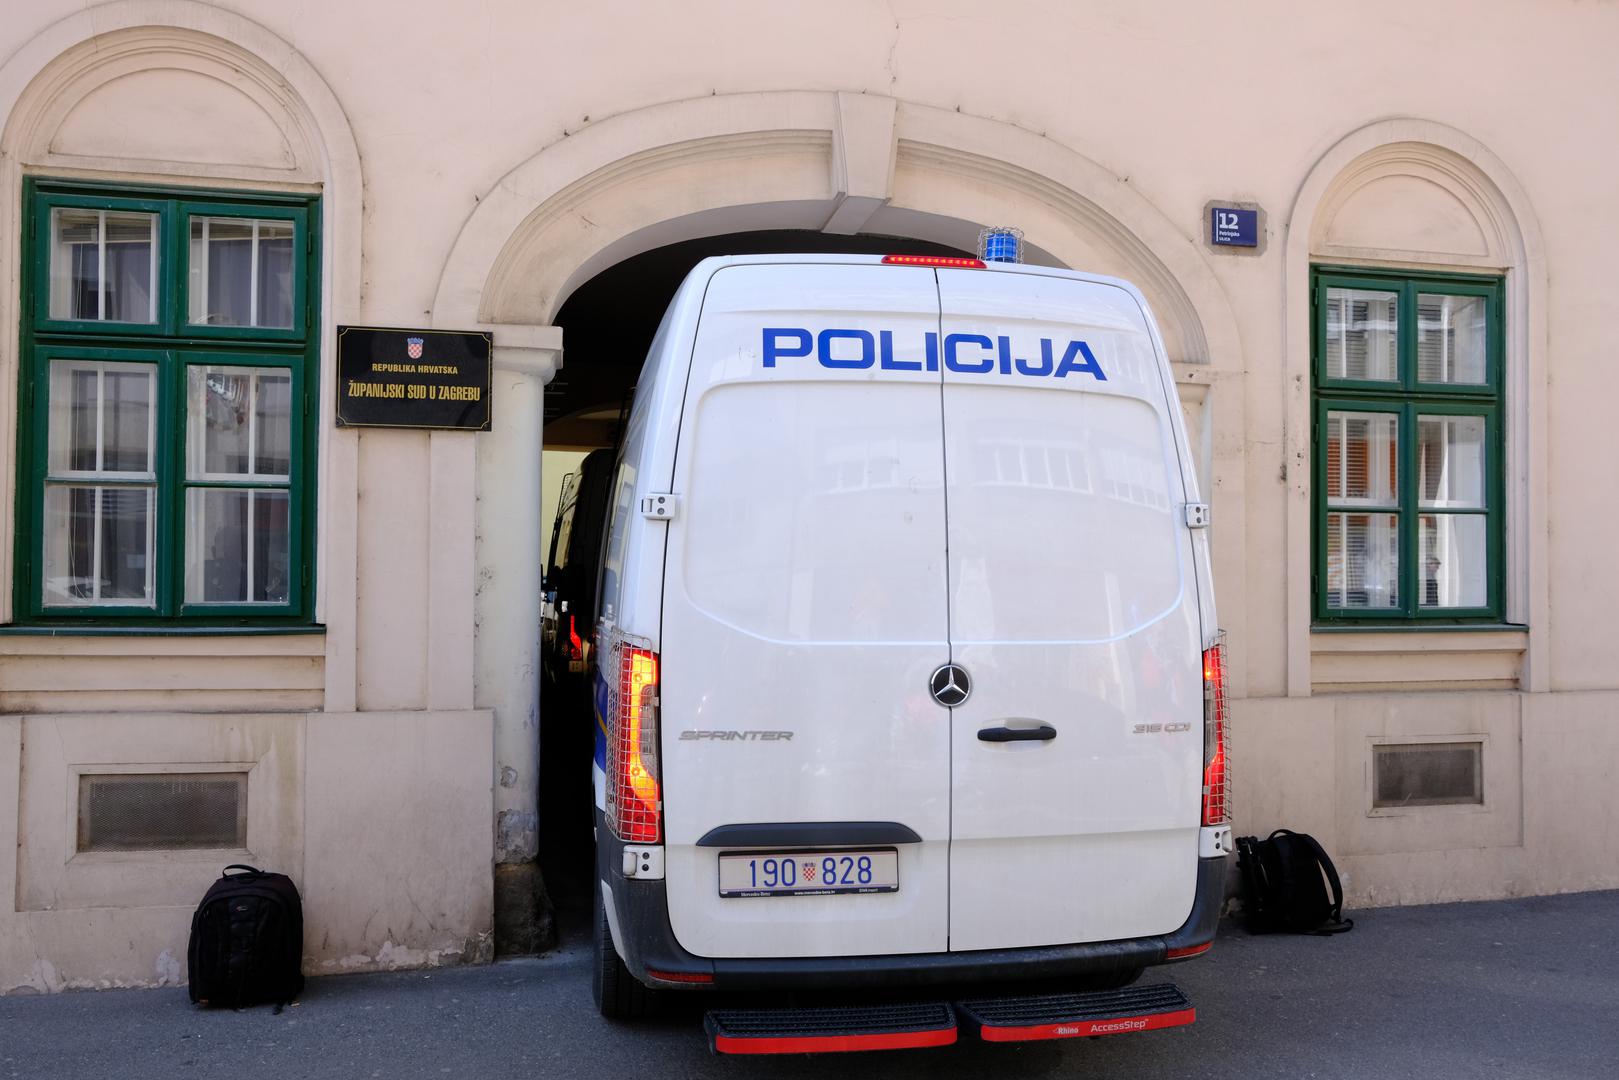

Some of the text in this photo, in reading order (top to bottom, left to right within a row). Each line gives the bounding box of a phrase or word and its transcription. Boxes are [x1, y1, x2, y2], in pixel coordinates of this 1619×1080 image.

[1219, 213, 1239, 230] 12
[762, 328, 1108, 381] POLICIJA
[371, 363, 459, 375] REPUBLIKA HRVATSKA
[348, 379, 480, 401] ŽUPANIJSKI SUD U ZAGREBU
[678, 730, 794, 741] SPRINTER
[750, 856, 872, 888] 190 828
[1057, 1027, 1079, 1035] Rhino
